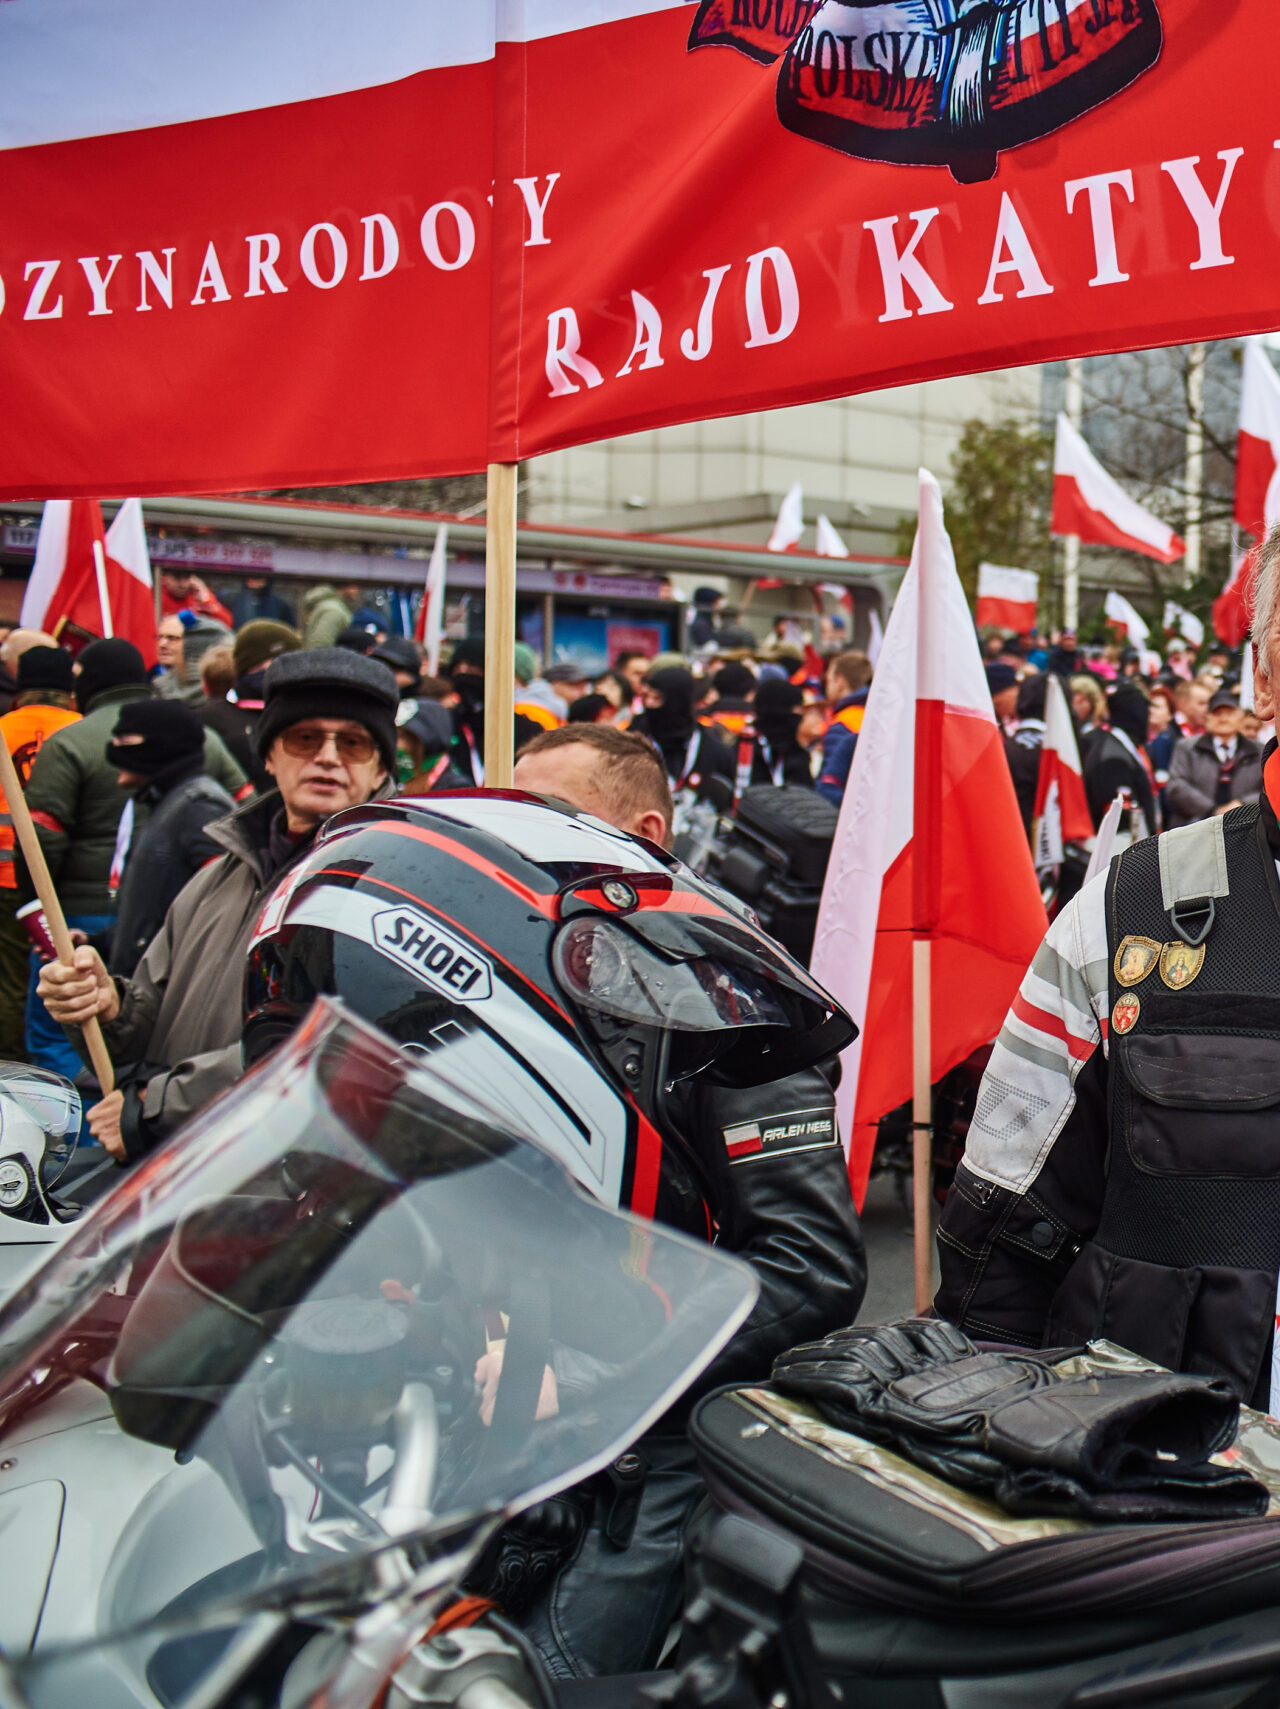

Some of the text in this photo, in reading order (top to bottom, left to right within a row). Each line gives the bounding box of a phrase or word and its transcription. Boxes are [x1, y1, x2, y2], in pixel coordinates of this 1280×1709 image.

[0, 172, 561, 321] ZYNARODOY
[545, 246, 799, 398] RAJD
[384, 916, 482, 994] SHOEI
